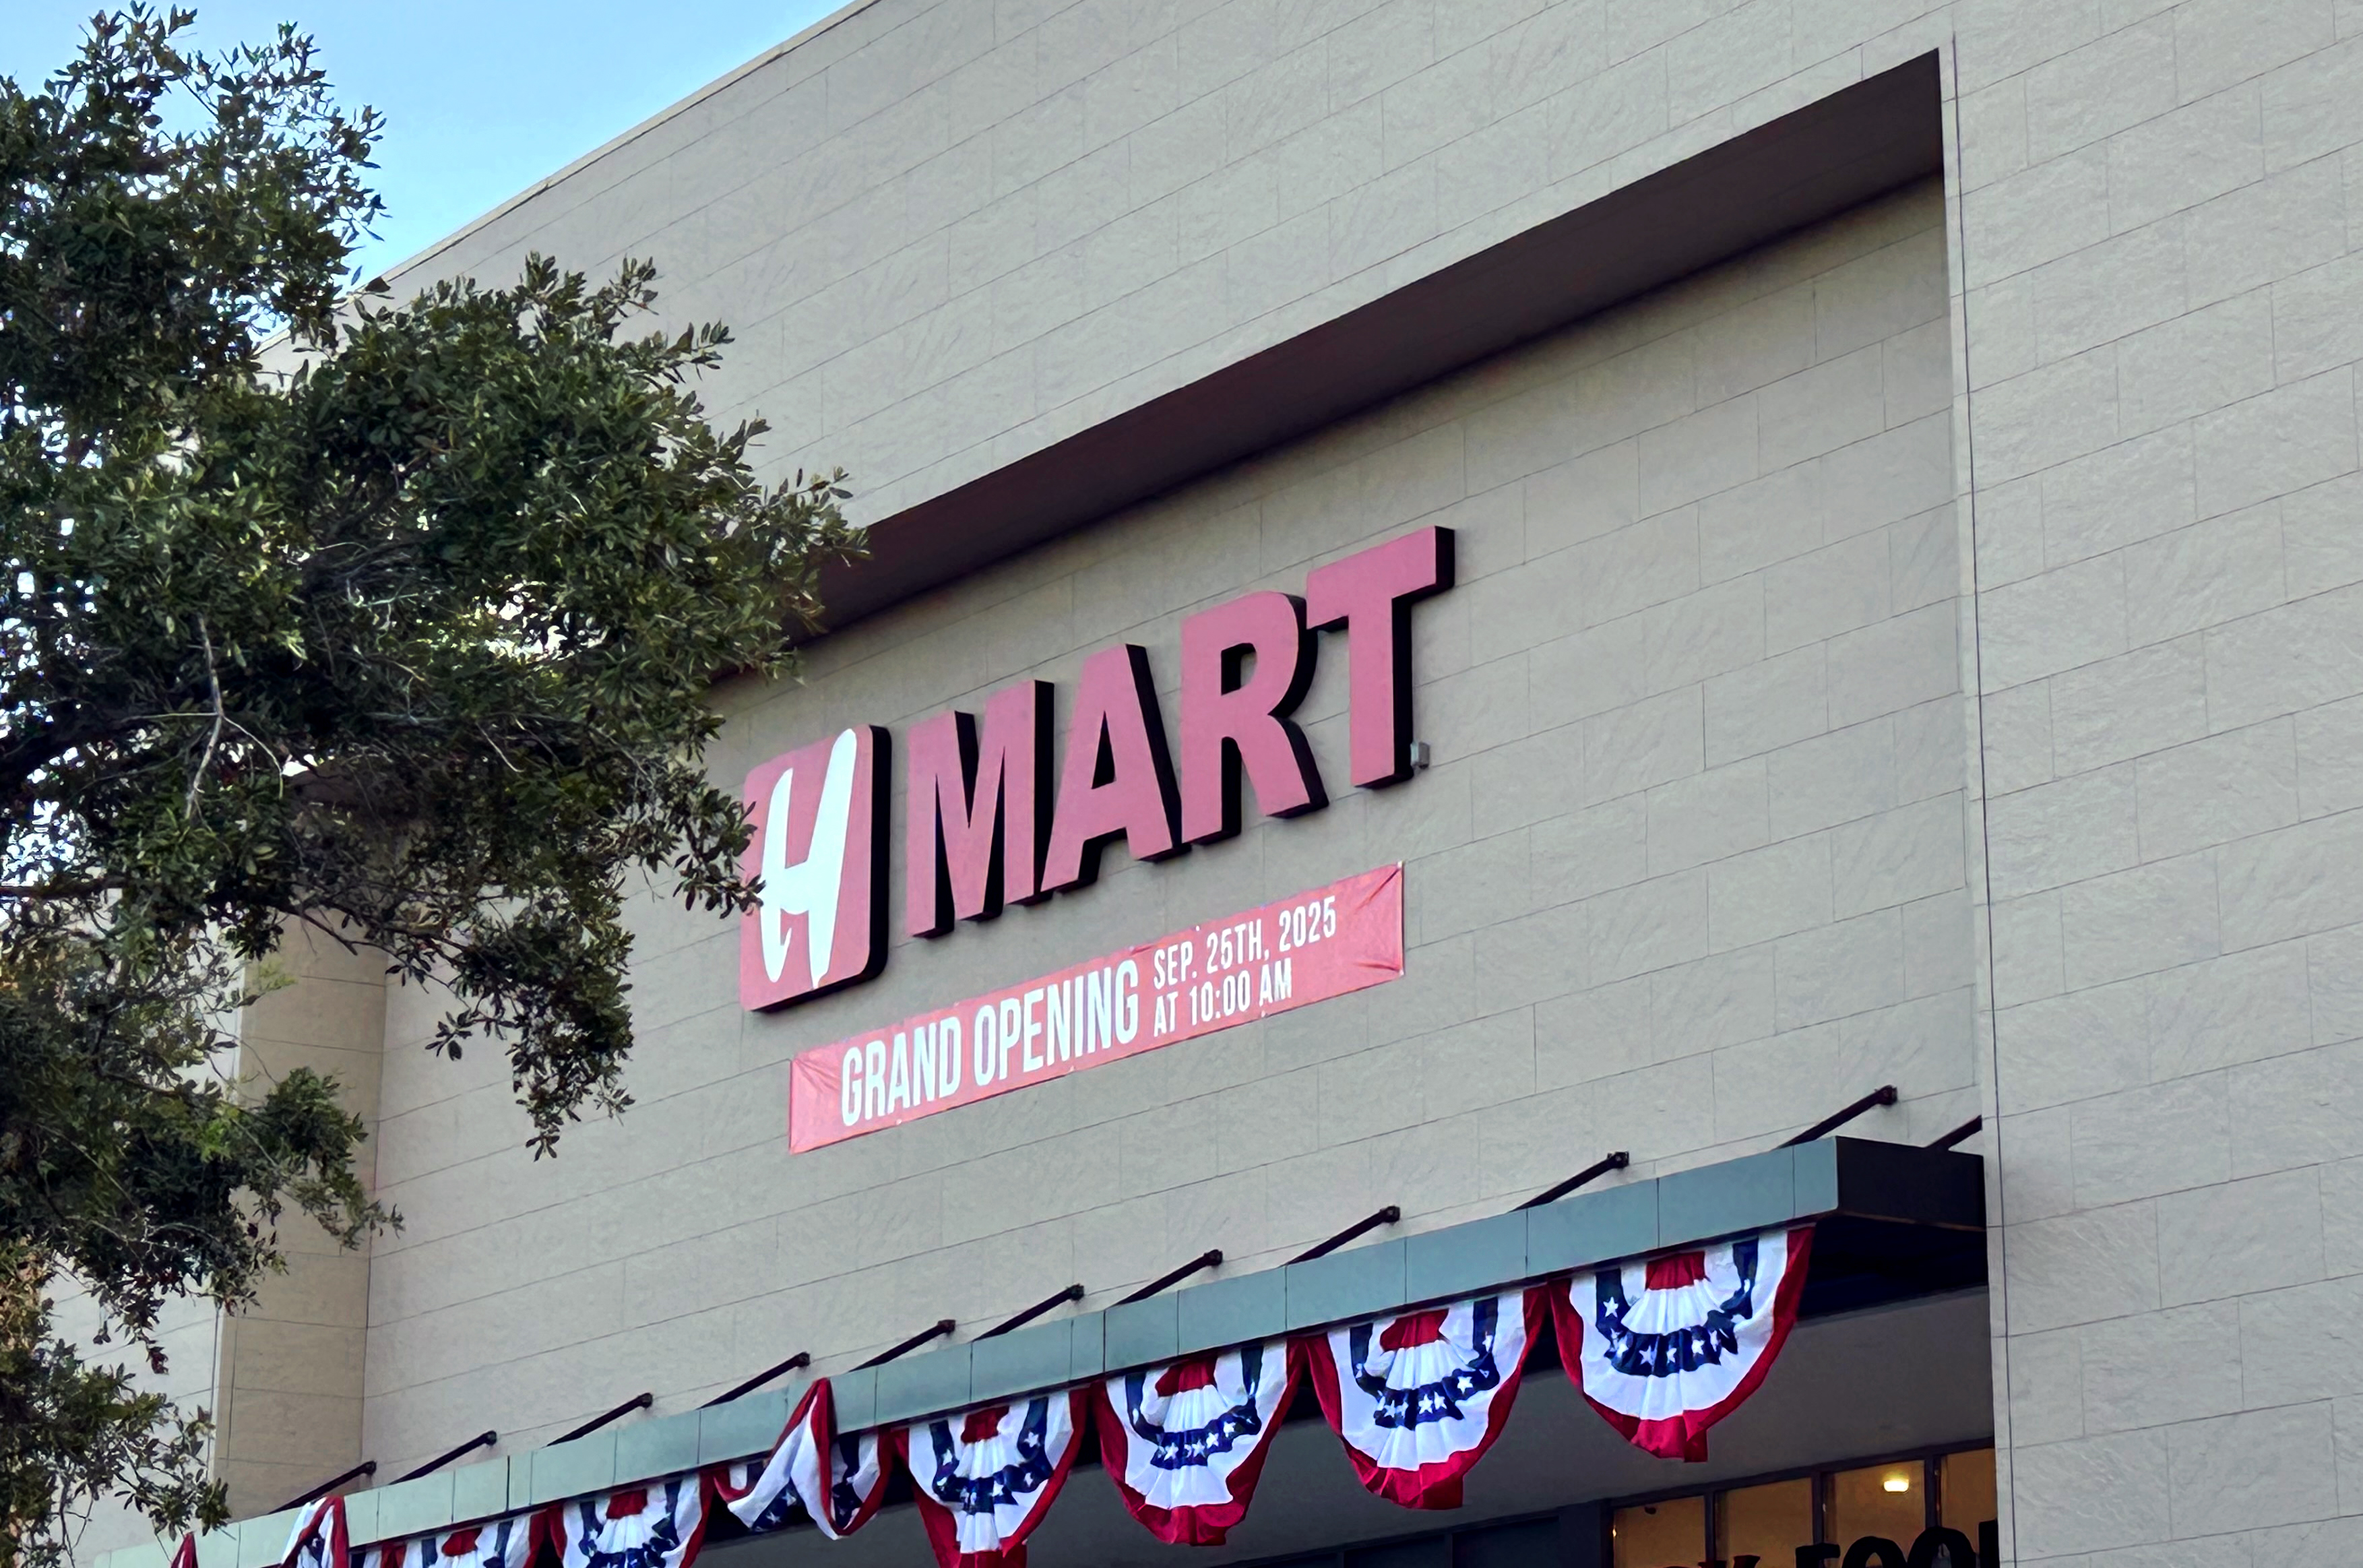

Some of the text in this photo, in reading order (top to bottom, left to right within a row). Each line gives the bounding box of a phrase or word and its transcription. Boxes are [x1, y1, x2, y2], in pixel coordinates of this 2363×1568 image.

[759, 525, 1455, 989] H MART
[1153, 895, 1337, 991] SEP. 25TH, 2025
[1153, 957, 1293, 1038] AT 10:00 AM
[840, 959, 1139, 1127] GRAND OPENING
